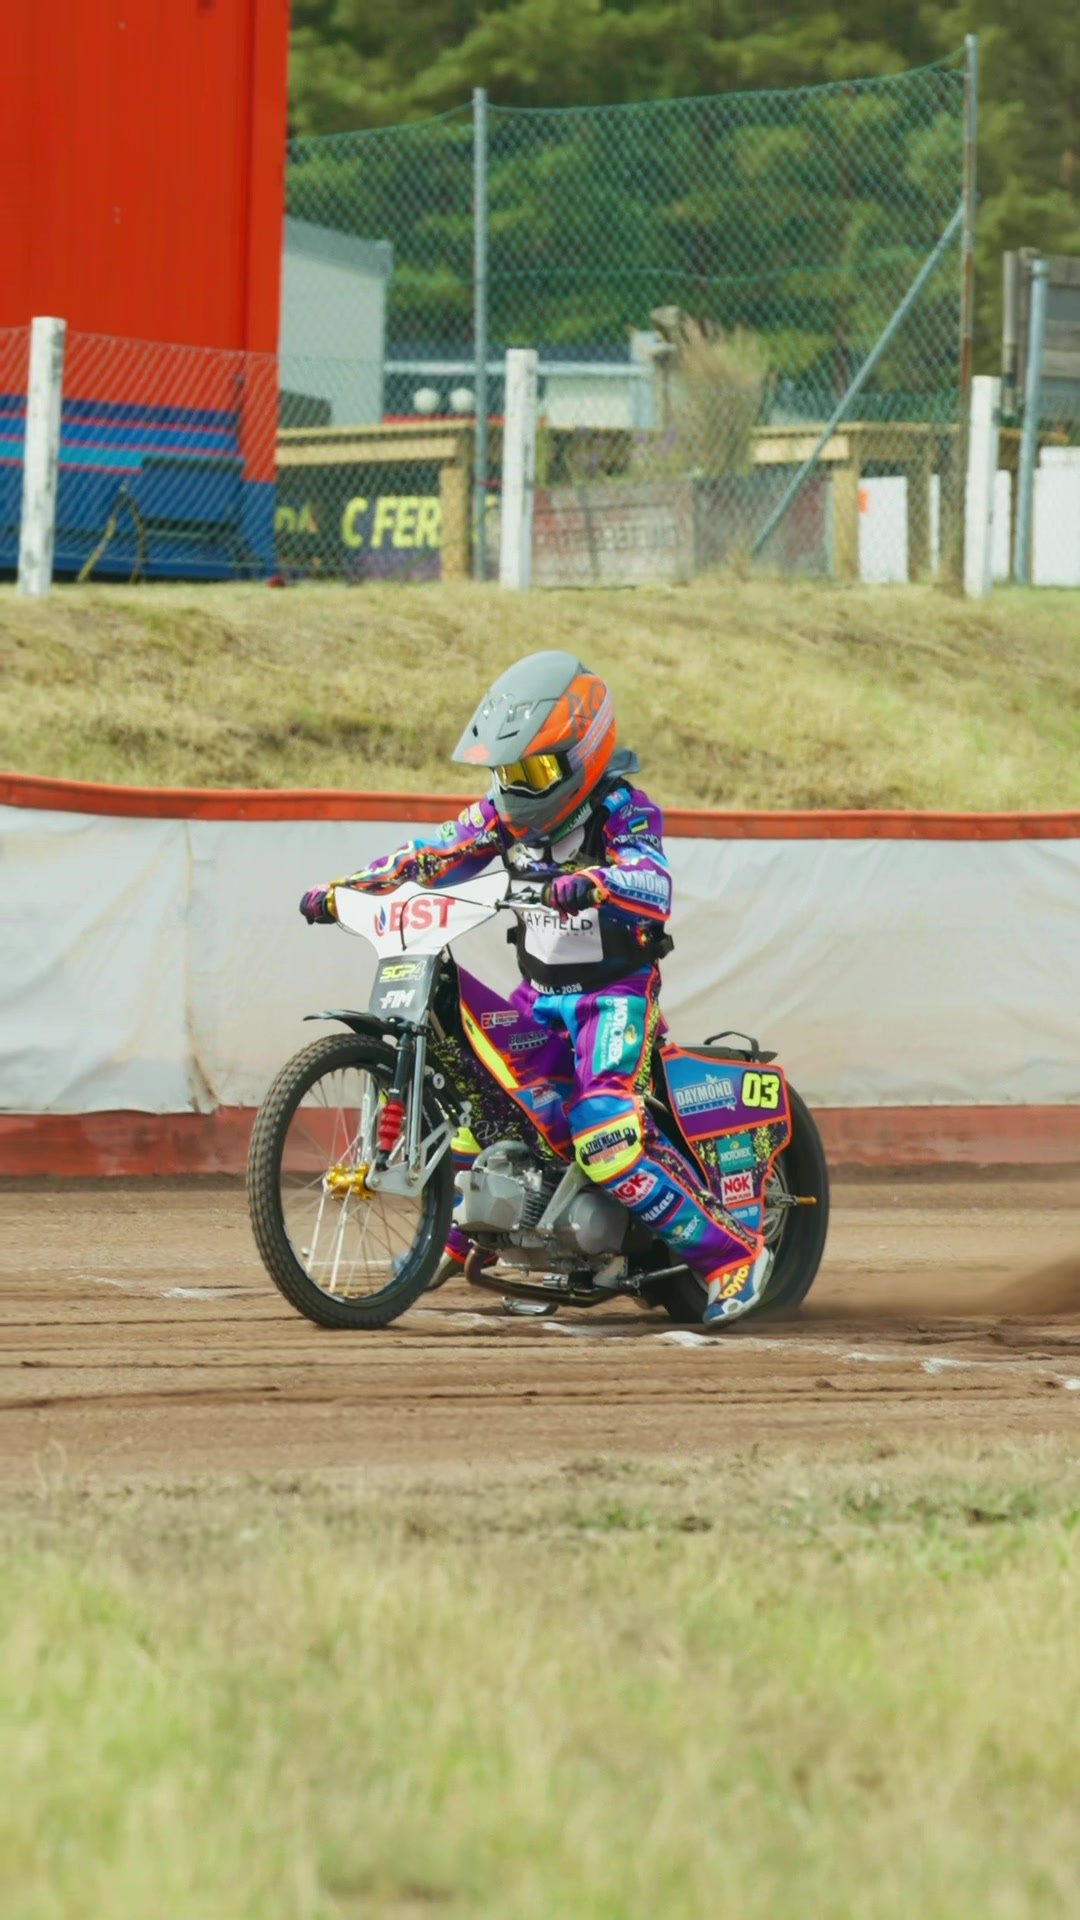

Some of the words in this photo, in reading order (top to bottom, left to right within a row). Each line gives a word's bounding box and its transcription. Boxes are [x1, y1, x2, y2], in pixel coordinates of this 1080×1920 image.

[602, 869, 670, 899] AYMOND
[389, 896, 456, 932] BST
[521, 911, 594, 932] AYFIELD
[561, 983, 583, 995] 2026
[675, 1080, 734, 1107] DAYMOND
[741, 1072, 780, 1110] 03
[585, 1129, 623, 1154] STRENGTH
[720, 1147, 752, 1163] MOTOREX
[723, 1175, 751, 1196] NGK
